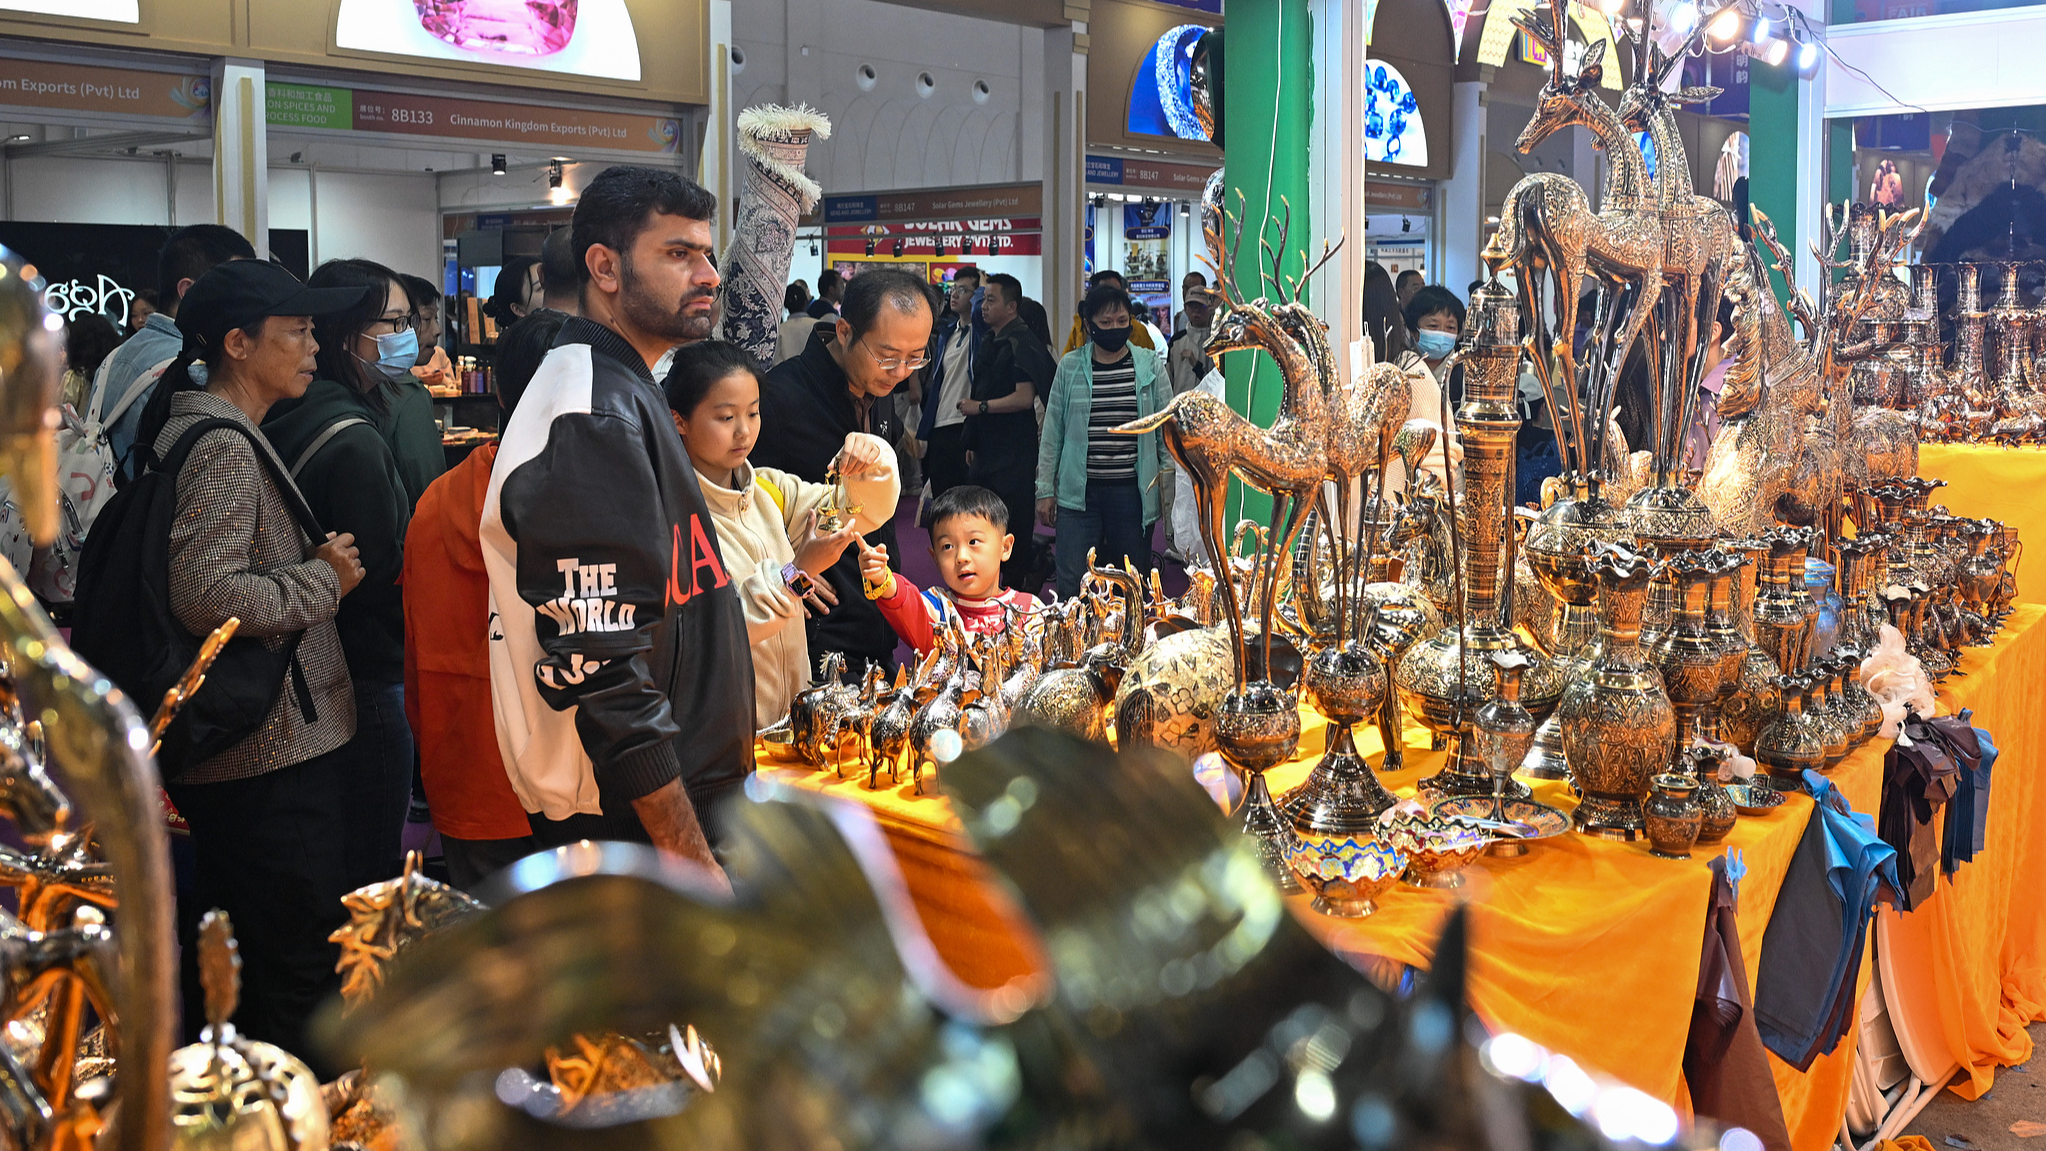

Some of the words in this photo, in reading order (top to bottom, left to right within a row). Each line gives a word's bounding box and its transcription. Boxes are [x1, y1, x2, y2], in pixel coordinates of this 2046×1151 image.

[21, 78, 77, 95] Exports
[80, 82, 114, 99] (Pvt)
[118, 86, 140, 99] Ltd
[265, 87, 332, 102] 香料和加工食品
[265, 100, 282, 109] ON
[283, 102, 315, 112] SPICES
[316, 104, 336, 114] AND
[301, 114, 327, 124] FOOD
[391, 108, 433, 124] 8B133
[450, 114, 503, 128] Cinnamon
[504, 118, 549, 133] Kingdom
[550, 122, 587, 135] Exports
[588, 125, 611, 138] (Pvt)
[612, 128, 627, 138] Ltd
[932, 201, 948, 209] Solar
[948, 200, 963, 209] Gems
[964, 199, 992, 209] Jewellery
[992, 197, 1008, 207] (Pvt)
[1008, 197, 1019, 206] Ltd
[904, 234, 962, 248] JEWEERY
[557, 557, 618, 599] THE
[536, 597, 637, 636] WORLD
